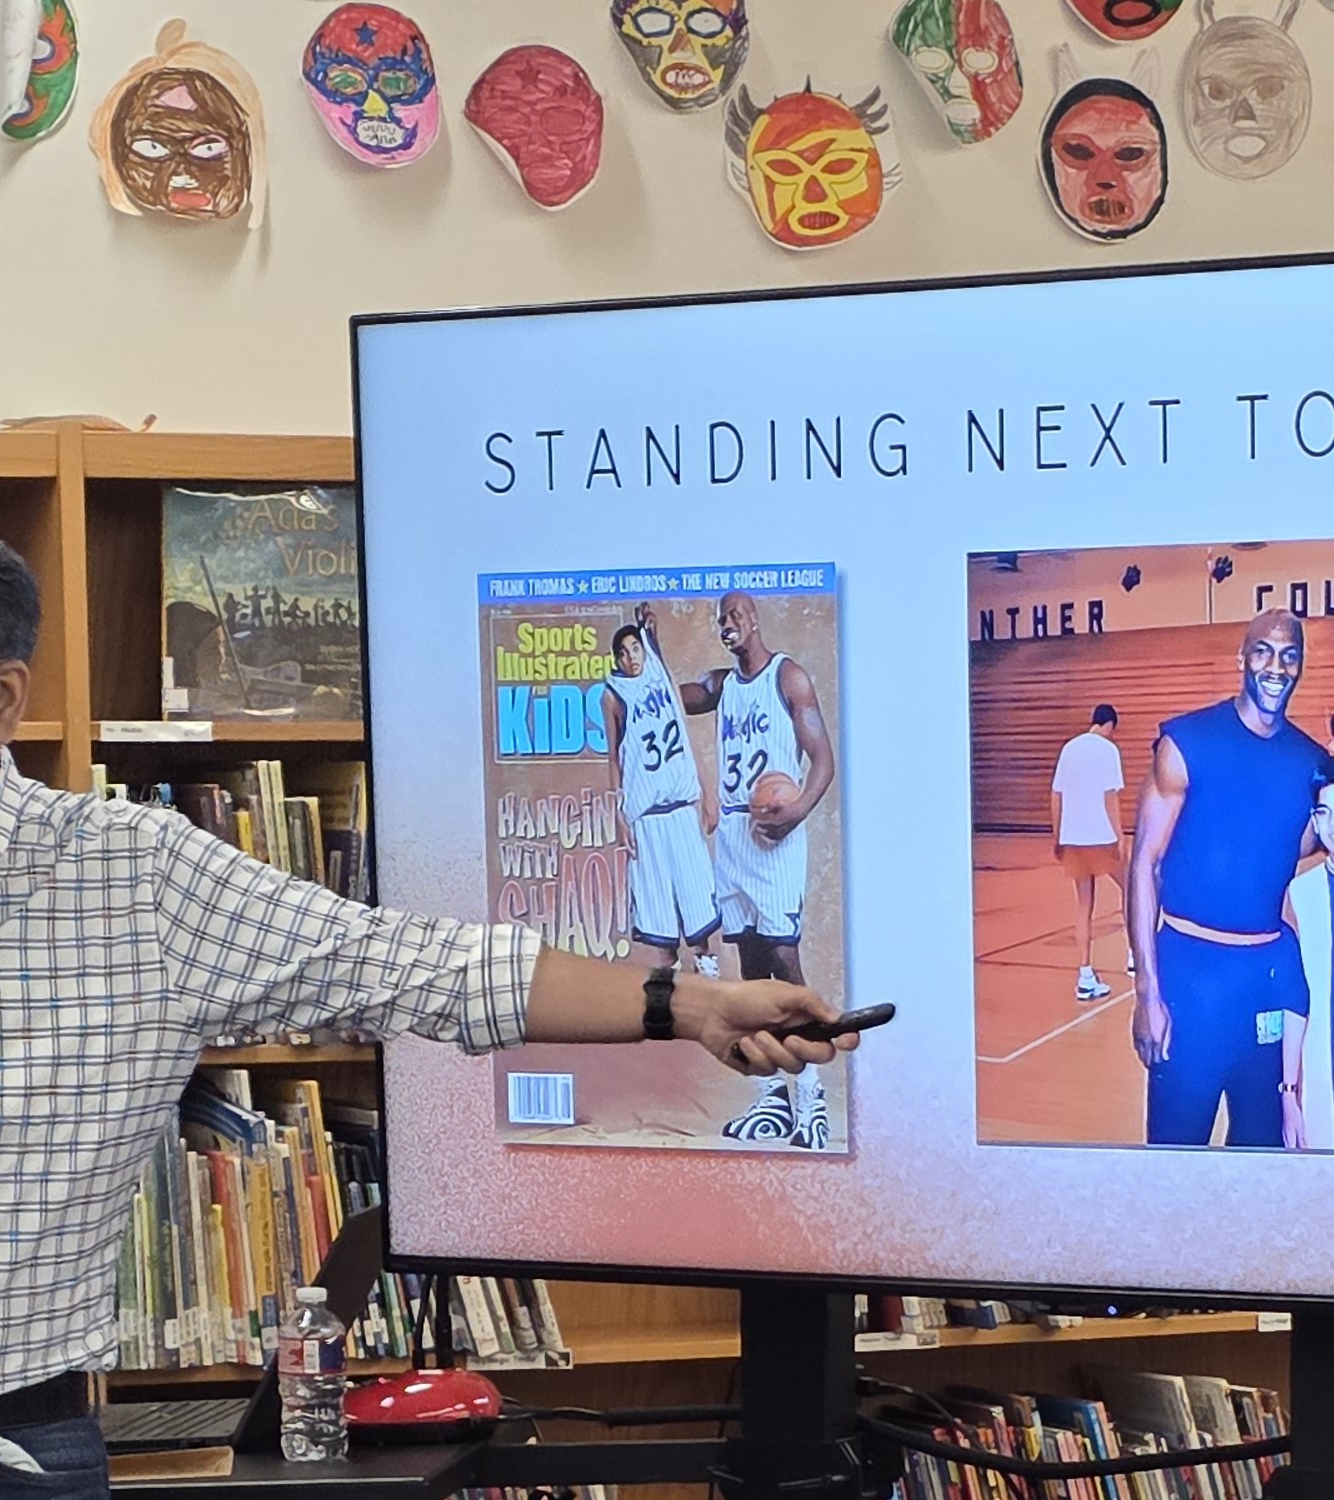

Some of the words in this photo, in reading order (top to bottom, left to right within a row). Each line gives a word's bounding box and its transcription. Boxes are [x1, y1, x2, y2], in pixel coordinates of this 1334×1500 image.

[484, 412, 910, 494] STANDING
[965, 399, 1181, 473] NEXT
[276, 536, 357, 576] Violi
[518, 623, 597, 654] Sports
[640, 718, 685, 773] 32
